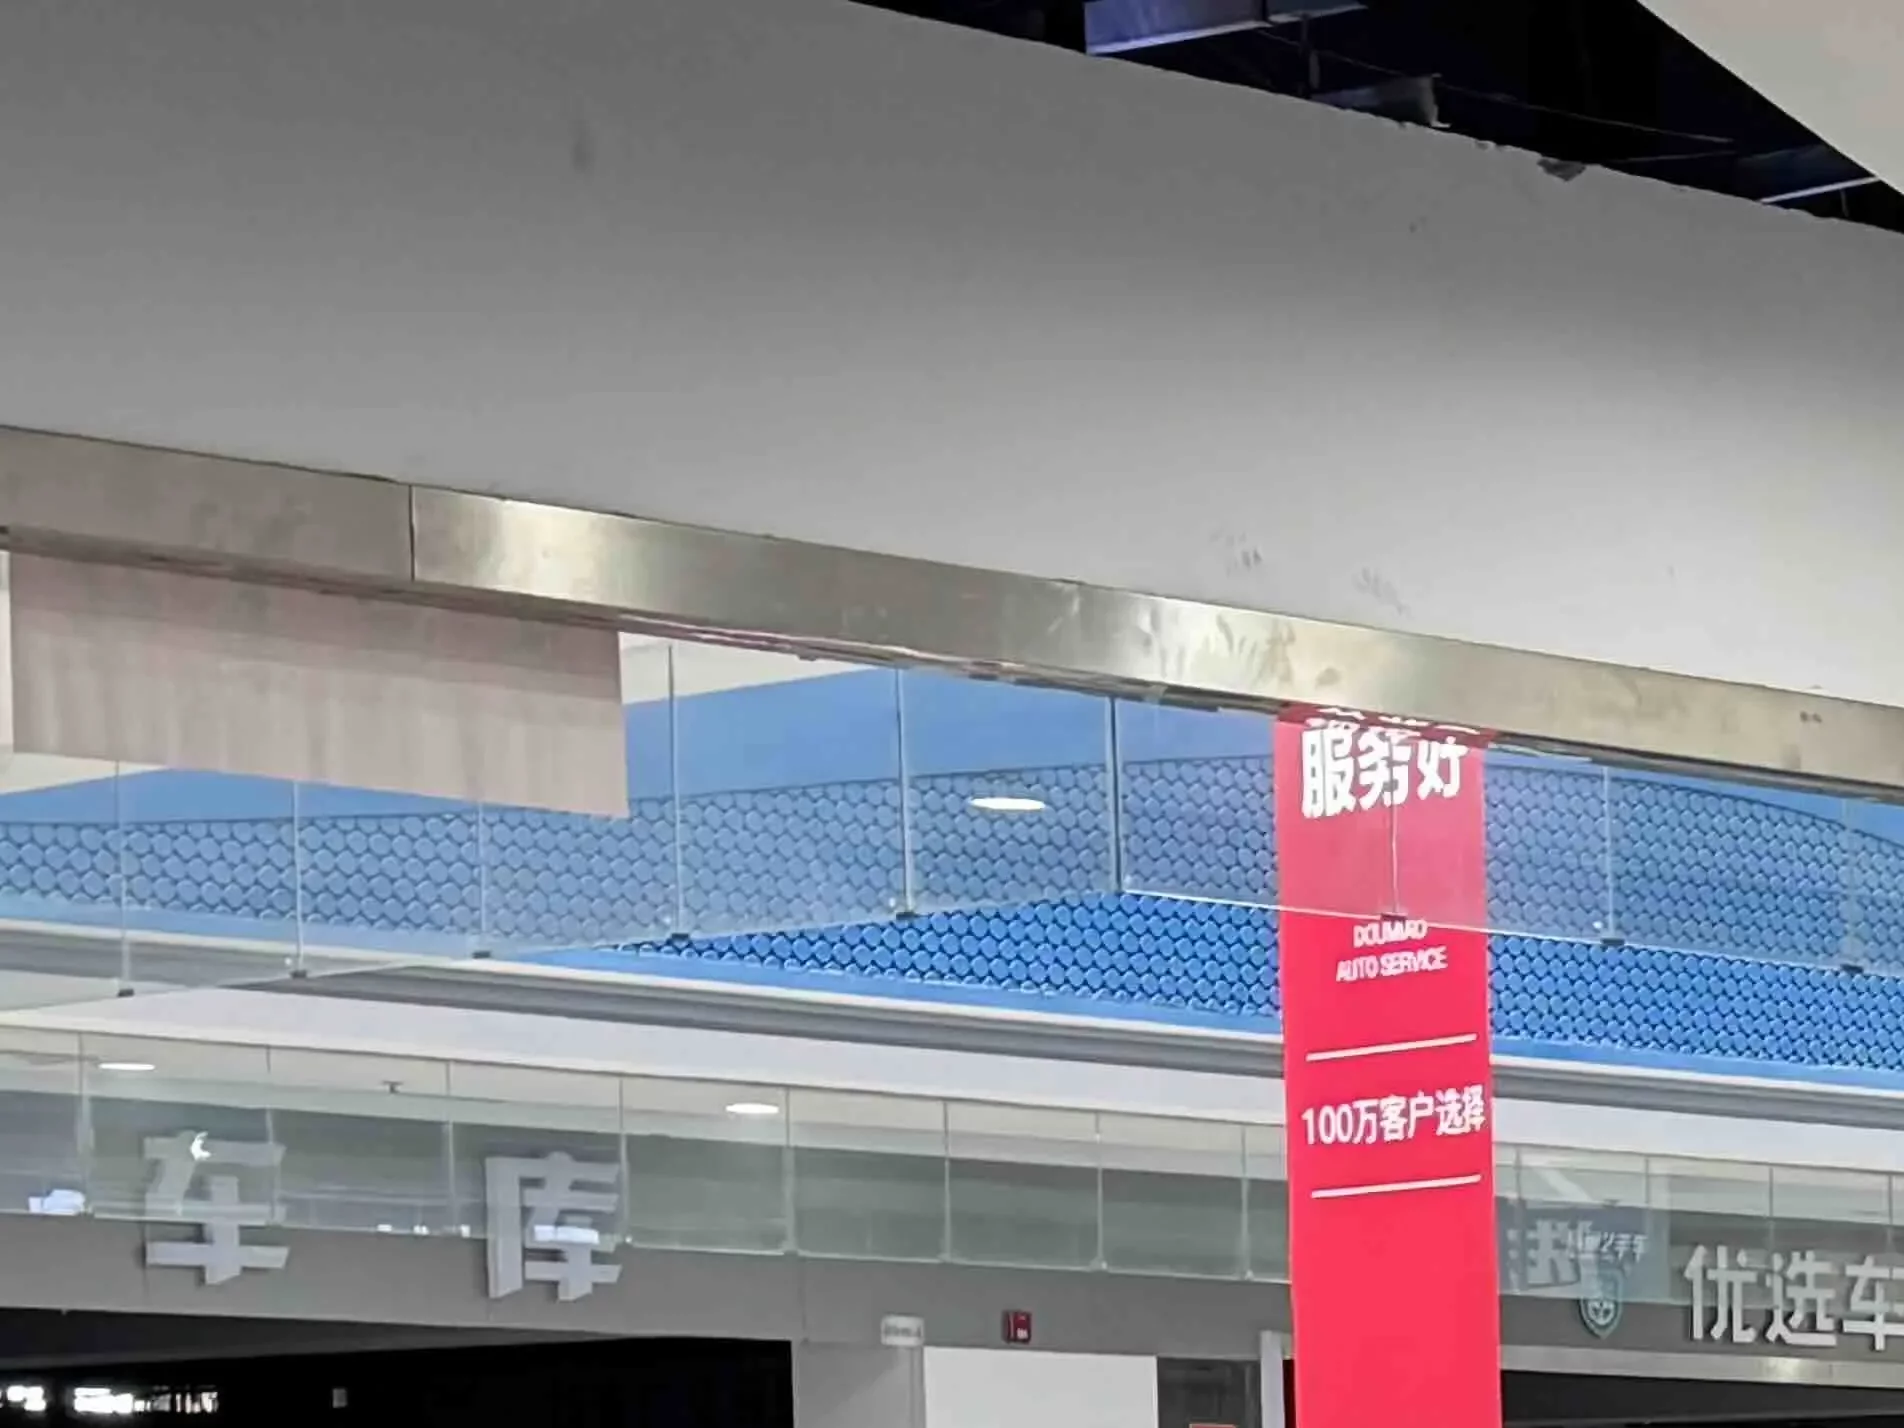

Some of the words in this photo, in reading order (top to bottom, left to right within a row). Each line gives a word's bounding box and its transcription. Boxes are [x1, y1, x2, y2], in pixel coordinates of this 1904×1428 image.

[1335, 953, 1379, 983] AUTO
[1379, 946, 1448, 977] SERVICE
[1302, 1085, 1486, 1146] 100万客户选择
